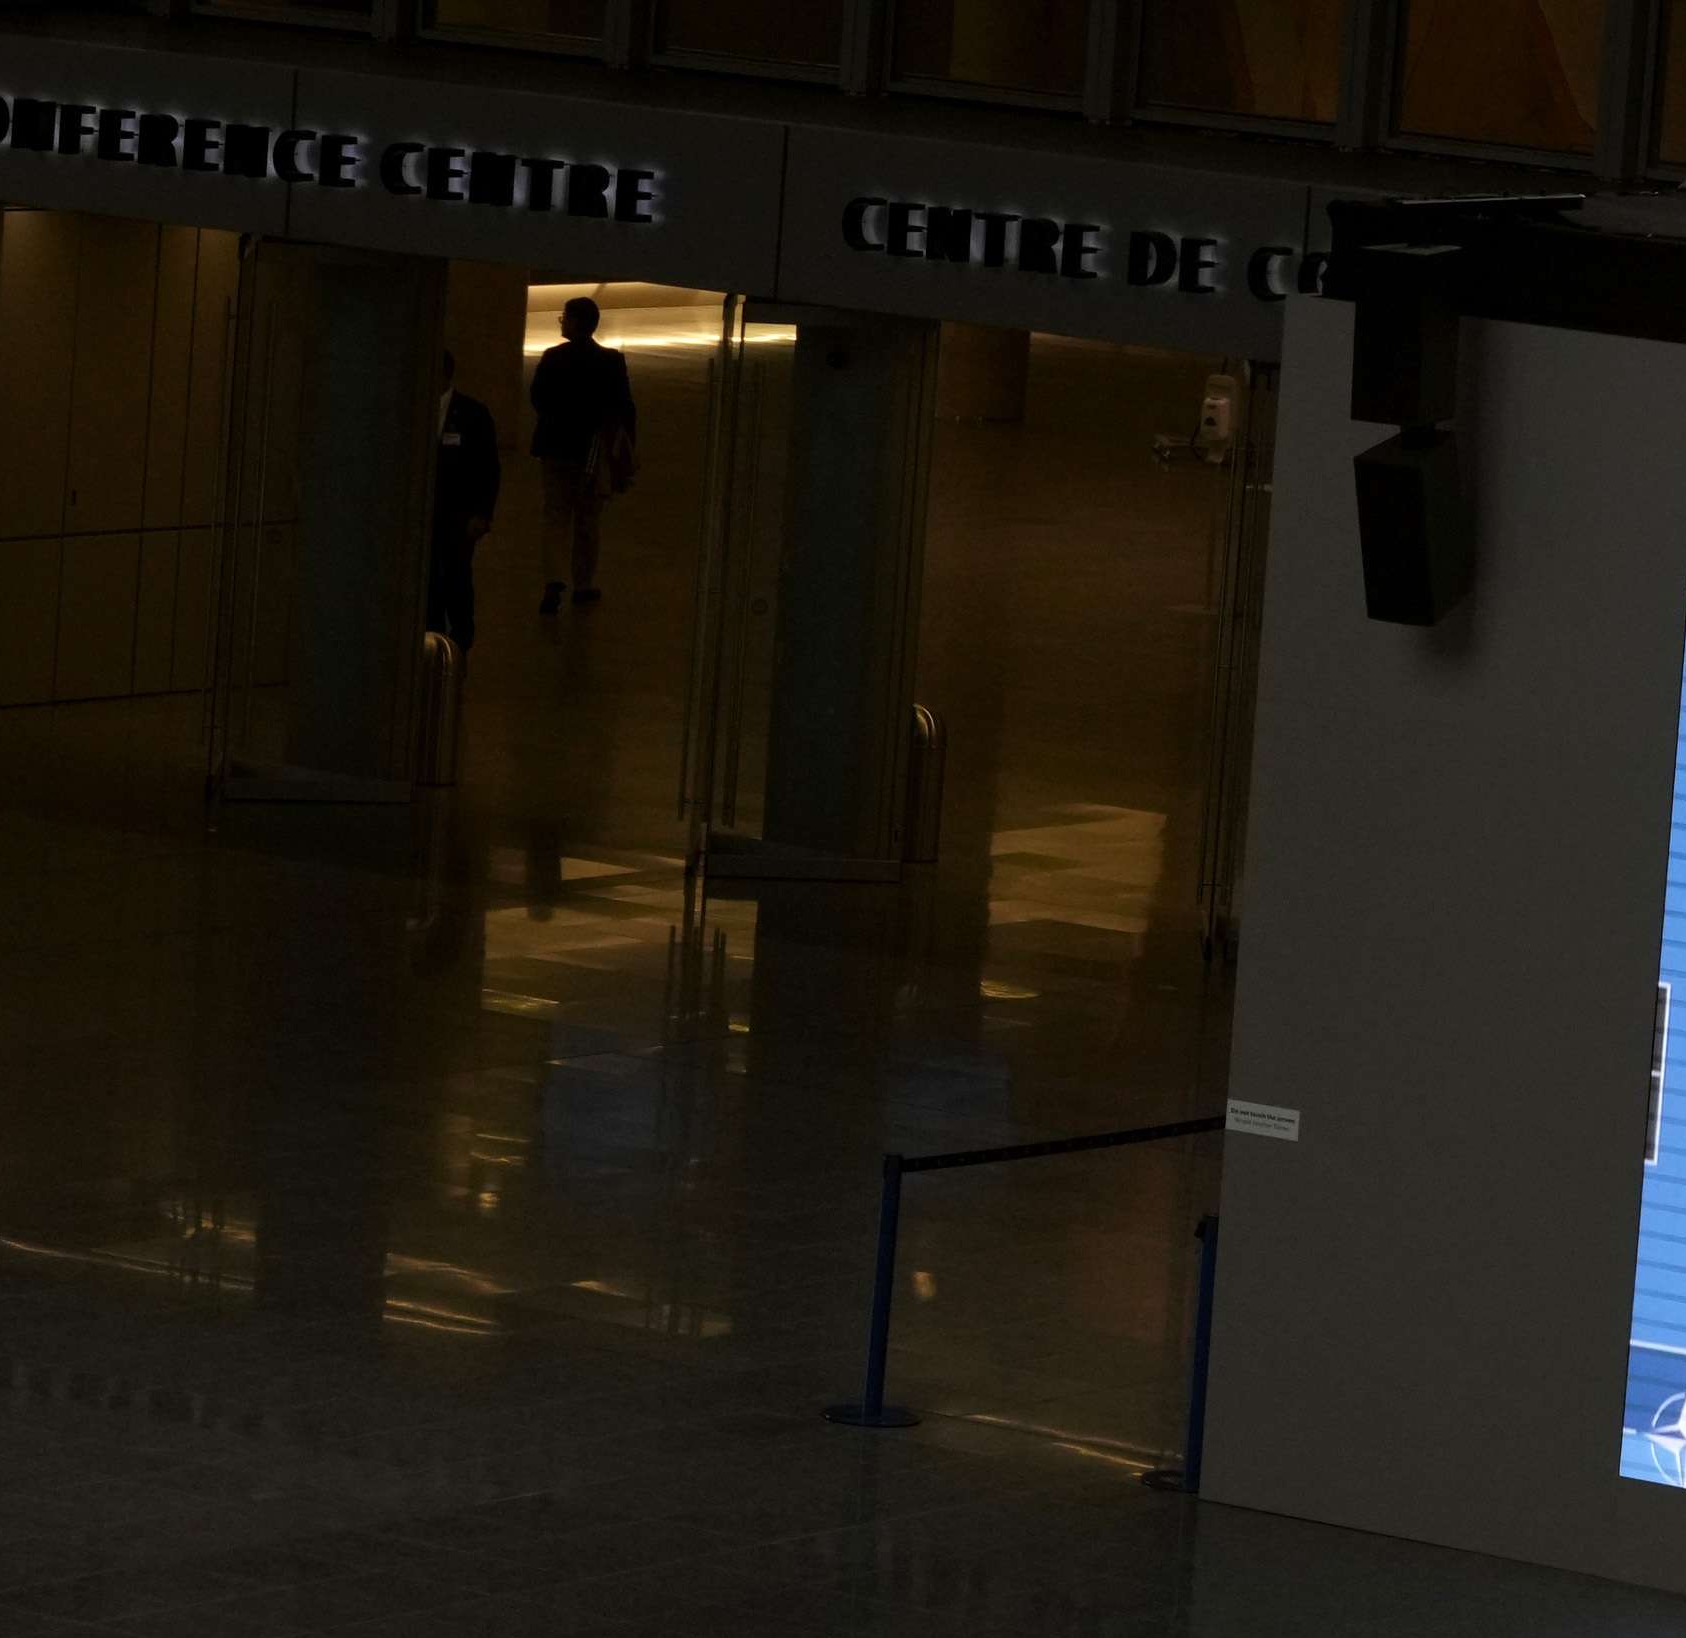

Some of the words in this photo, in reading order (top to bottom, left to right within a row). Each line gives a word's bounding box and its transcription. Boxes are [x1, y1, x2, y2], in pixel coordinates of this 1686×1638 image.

[380, 142, 655, 223] CENTRE
[842, 197, 1100, 279] CENTRE
[1128, 230, 1217, 293] DE
